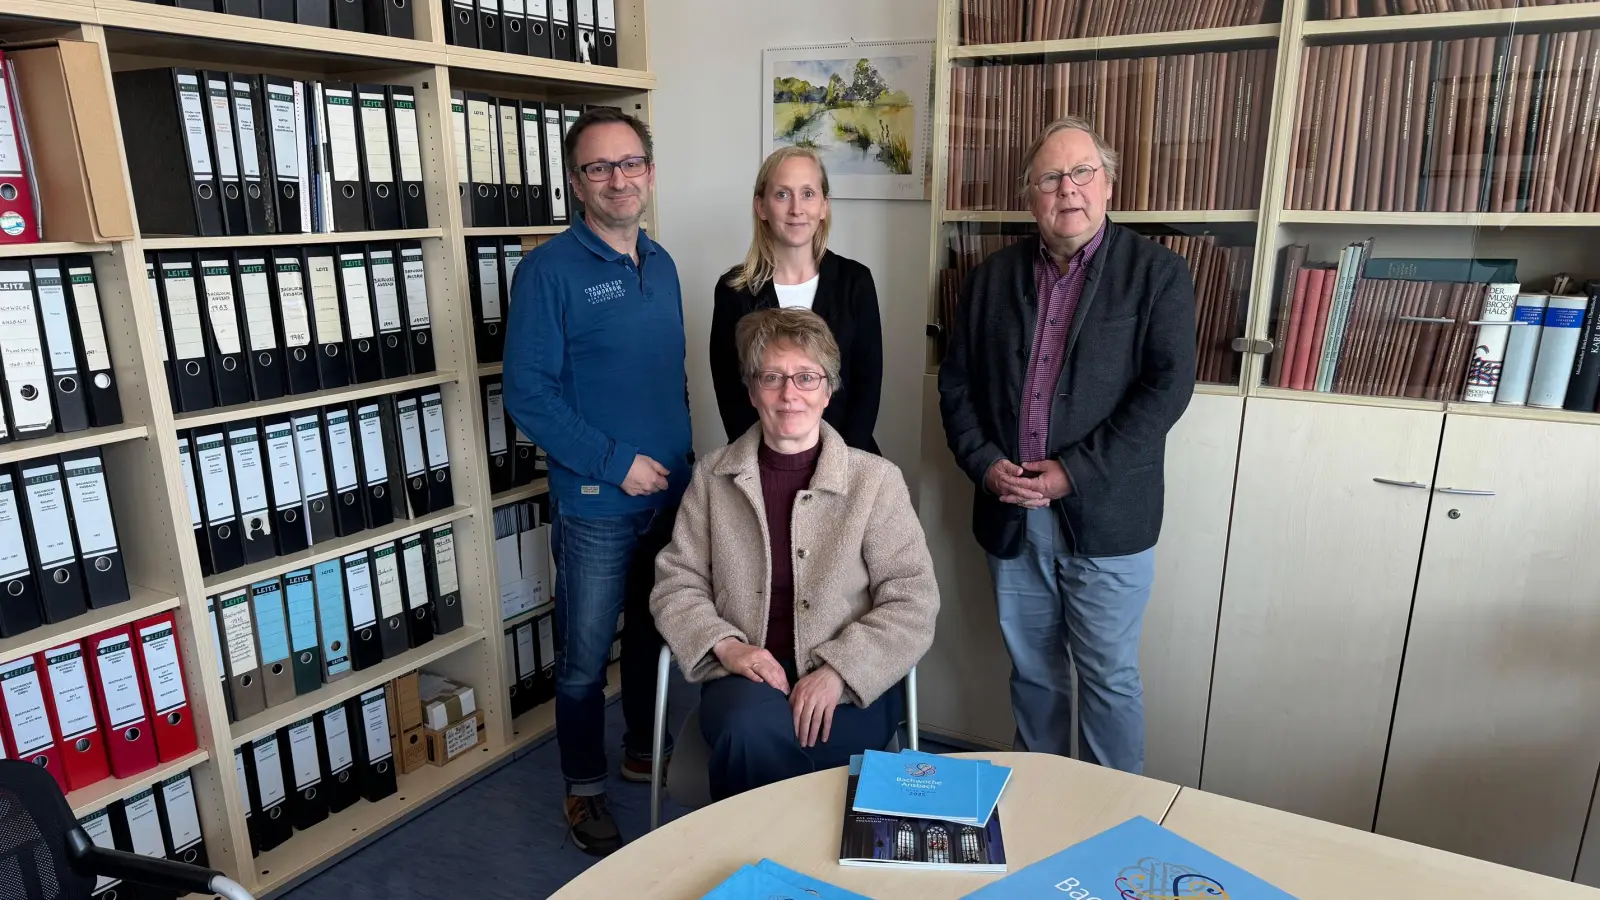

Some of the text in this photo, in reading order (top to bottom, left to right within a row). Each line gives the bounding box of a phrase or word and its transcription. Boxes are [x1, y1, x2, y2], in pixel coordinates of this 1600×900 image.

[329, 97, 350, 105] LEITZ
[396, 101, 413, 109] LEITZ
[206, 267, 228, 275] LEITZ
[242, 265, 263, 273] LEITZ
[71, 275, 92, 283] LEITZ
[584, 282, 610, 294] CRAFTED
[589, 285, 622, 298] TOMORROW
[1487, 294, 1515, 302] MUSIK
[1486, 301, 1514, 309] BROCK
[1484, 308, 1508, 316] HAUS
[1589, 332, 1600, 354] KARL
[235, 436, 253, 444] LEITZ
[202, 441, 221, 450] LEITZ
[72, 466, 97, 476] LEITZ
[31, 474, 54, 484] LEITZ
[376, 547, 393, 557] LEITZ
[289, 575, 309, 584] LEITZ
[256, 584, 277, 594] LEITZ
[224, 596, 245, 607] LEITZ
[151, 629, 170, 640] LEITZ
[106, 642, 126, 653] LEITZ
[57, 652, 78, 662] LEITZ
[331, 657, 345, 665] LEITZ
[10, 666, 32, 677] LEITZ
[896, 776, 942, 786] Bachwoche
